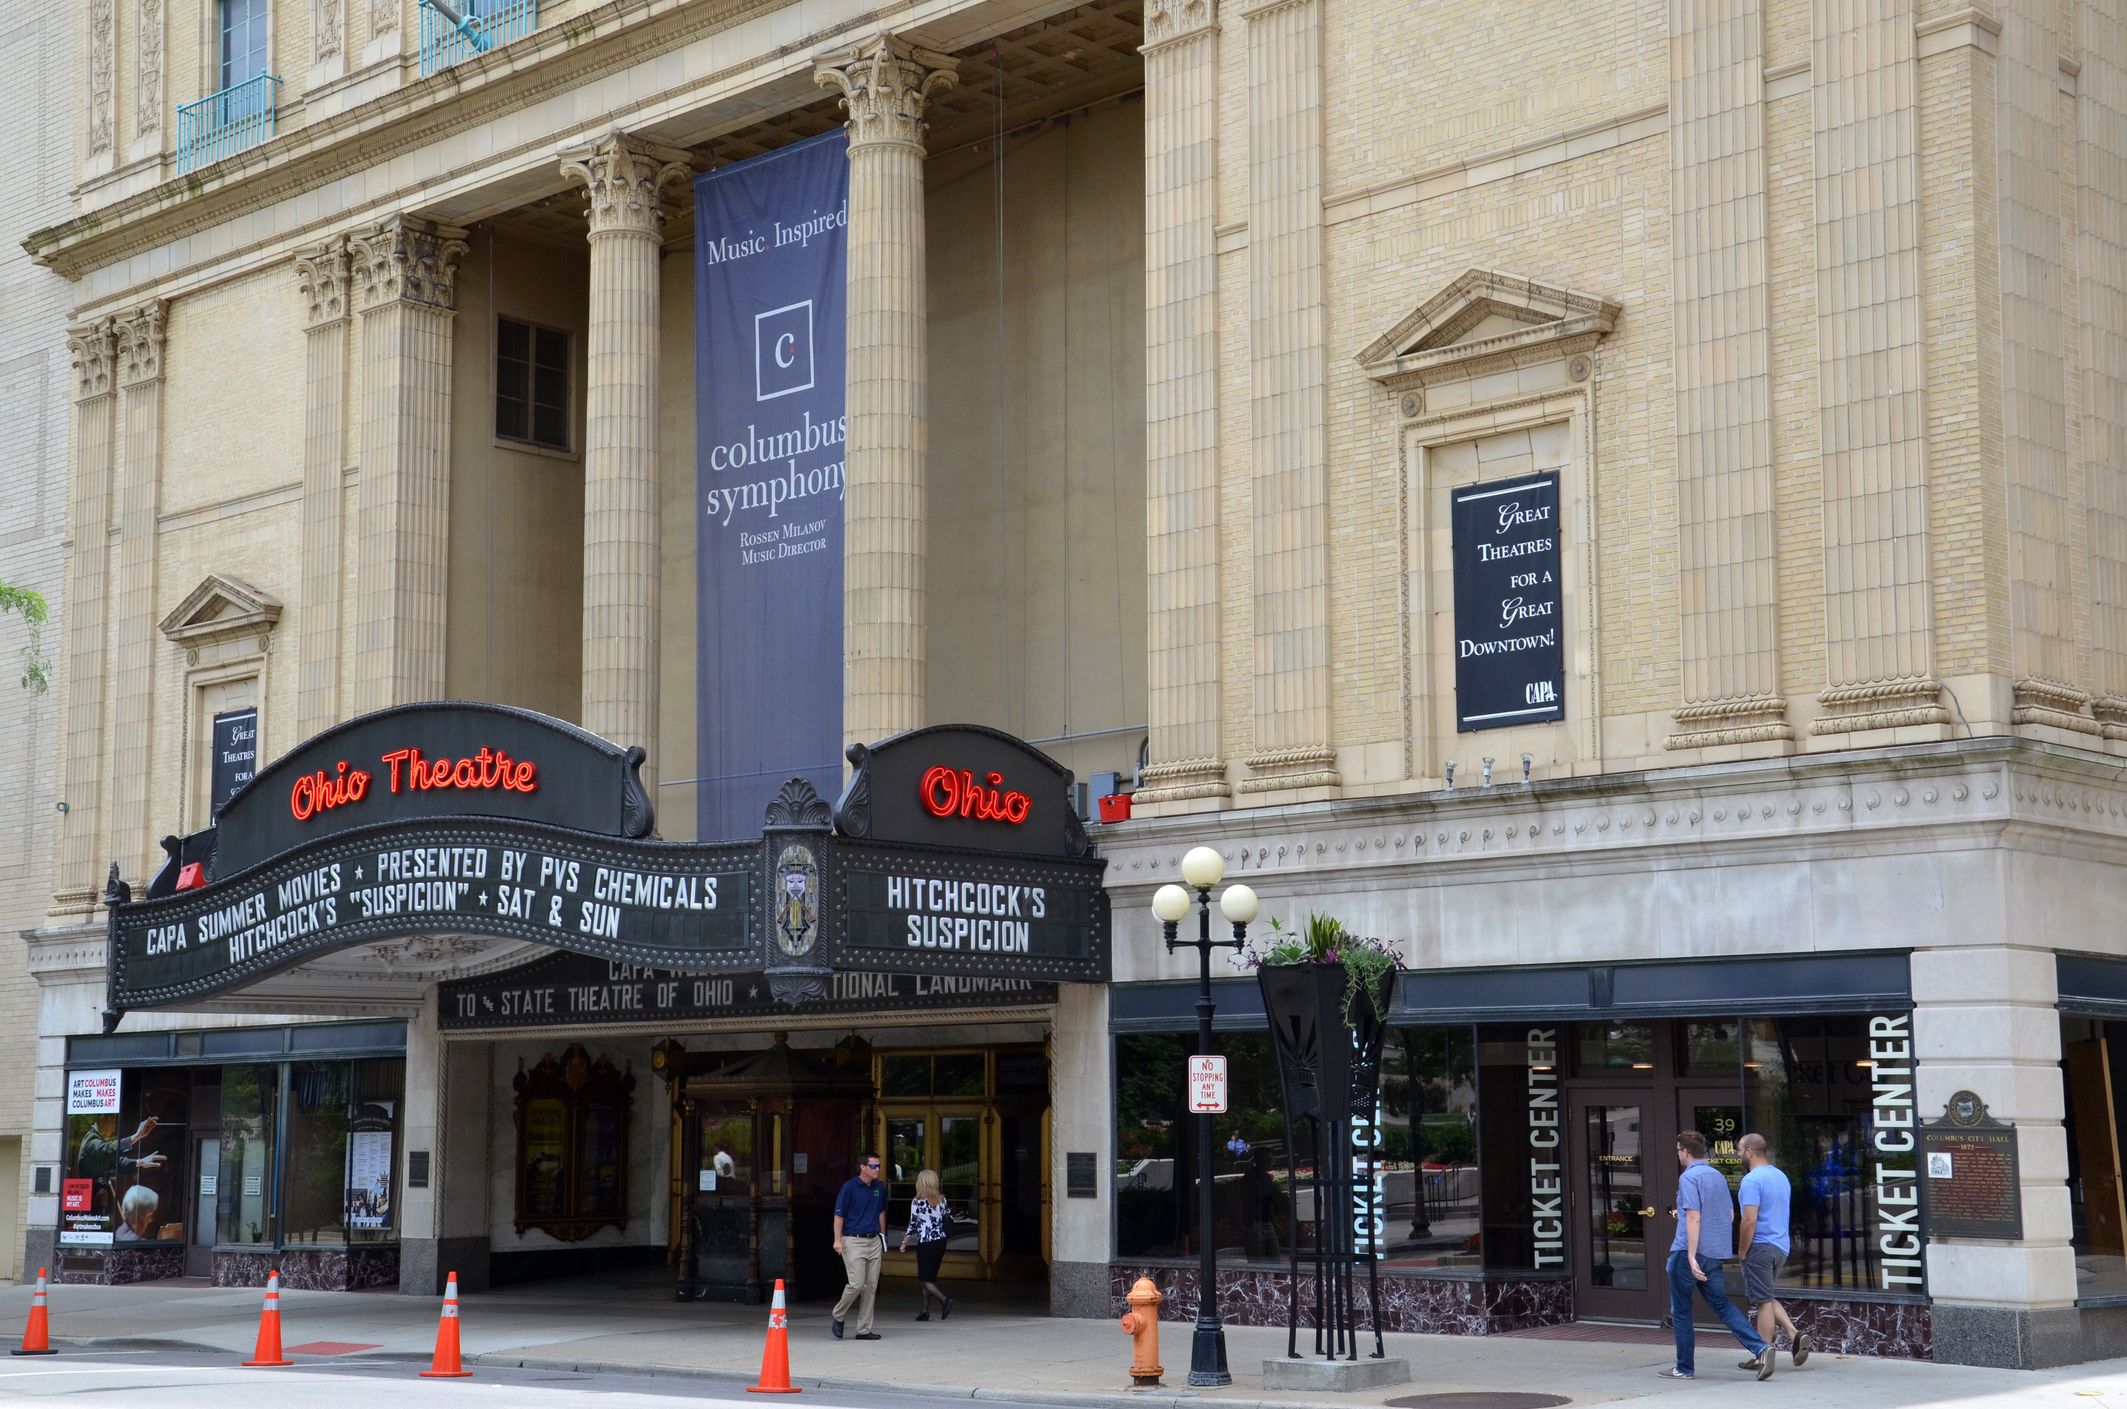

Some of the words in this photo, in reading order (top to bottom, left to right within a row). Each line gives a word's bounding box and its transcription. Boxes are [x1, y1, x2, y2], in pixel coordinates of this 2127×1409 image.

[707, 229, 765, 265] Music
[774, 199, 848, 248] Inspired
[711, 411, 846, 472] columbus
[707, 459, 846, 526] symphony
[1496, 502, 1550, 534] GREAT
[740, 529, 780, 548] ROSSEN
[782, 519, 826, 539] MILANOV
[742, 549, 776, 565] MUSIC
[778, 538, 826, 558] DIRECTOR
[1478, 538, 1552, 561] THEATRES
[1511, 572, 1537, 588] FOR
[1543, 570, 1552, 583] A
[1499, 597, 1553, 628] GREAT
[1460, 628, 1555, 658] DOWNTOWN!
[1525, 681, 1557, 704] CAPA
[231, 726, 255, 746] GREAT
[223, 750, 254, 763] THEATRES
[235, 772, 247, 782] FOR
[291, 760, 371, 822] Ohio
[381, 745, 538, 794] Theatre
[920, 765, 1032, 824] Ohio
[146, 923, 186, 955] CAPA
[198, 893, 266, 943] SUMMER
[278, 864, 341, 911] MOVIES
[377, 848, 488, 881] PRESENTED
[501, 851, 527, 882] BY
[540, 857, 580, 893] PVS
[594, 868, 717, 910] CHEMICALS
[887, 876, 1046, 918] HITCHCOCK'S
[228, 897, 336, 963] HITCHCOCK'S
[350, 881, 469, 917] "SUSPICION"
[497, 885, 536, 920] SAT
[549, 895, 563, 927] &
[580, 901, 620, 939] SUN
[906, 914, 1030, 953] SUSPICION
[457, 994, 476, 1017] TO
[501, 988, 555, 1015] STATE
[568, 983, 644, 1012] THEATRE
[657, 982, 680, 1007] OF
[693, 979, 733, 1006] OHIO
[826, 972, 899, 999] TIONAL
[1193, 1073, 1223, 1082] STOPPING
[1202, 1062, 1213, 1071] NO
[73, 1080, 84, 1088] ART
[85, 1078, 117, 1087] COLUMBUS
[73, 1089, 92, 1098] MAKES
[96, 1089, 116, 1097] MAKES
[1200, 1091, 1216, 1099] TIME
[1202, 1083, 1215, 1091] ANY
[1527, 1028, 1560, 1148] CENTER
[1869, 1015, 1915, 1152] CENTER
[72, 1099, 104, 1108] COLUMBUS
[104, 1099, 116, 1107] ART
[1714, 1118, 1735, 1131] 39
[1926, 1134, 1965, 1142] COLUMBUS
[1706, 1157, 1723, 1165] CKET
[1714, 1140, 1737, 1155] CAPA
[1531, 1158, 1564, 1269] TICKET
[1875, 1162, 1923, 1290] TICKET
